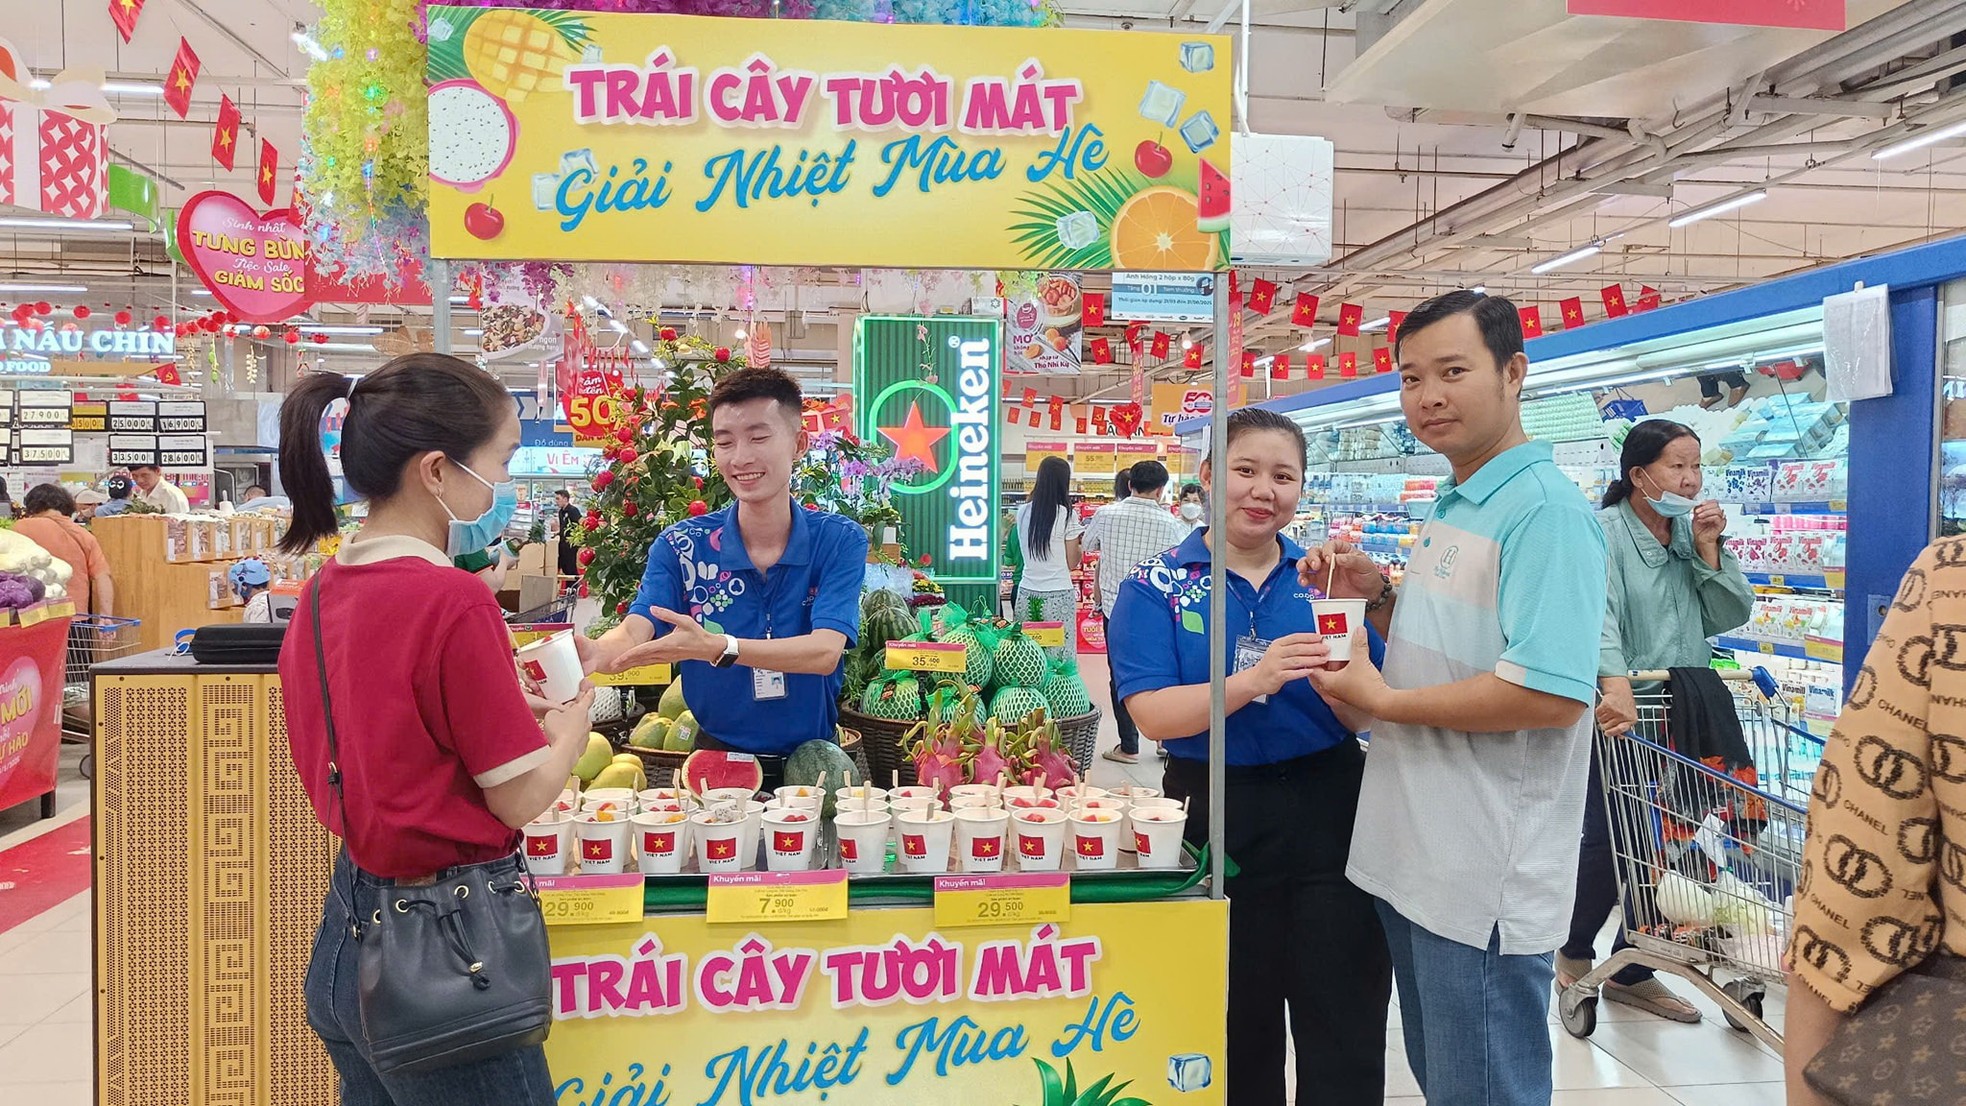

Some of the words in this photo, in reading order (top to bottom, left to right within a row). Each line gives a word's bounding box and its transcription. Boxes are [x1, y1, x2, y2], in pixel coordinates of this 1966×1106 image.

[570, 52, 692, 119] TRÁI
[710, 58, 813, 123] CÂY
[827, 70, 948, 126] TƯƠI
[964, 64, 1078, 131] MÁT
[556, 158, 673, 232] Giải
[695, 138, 857, 212] Nhiệt
[872, 134, 1007, 198] Mùa
[214, 269, 265, 291] GIẢM
[270, 269, 305, 293] SỐC
[263, 260, 291, 274] Sale
[13, 320, 84, 352] NẤU
[90, 325, 176, 354] CHÍN
[6, 360, 51, 373] FOOD
[950, 338, 990, 561] Heineken
[1877, 699, 1931, 733] CHANEL
[1843, 800, 1889, 836] CHANEL
[713, 874, 744, 886] Khuyến
[746, 873, 762, 883] mãi
[939, 878, 969, 889] Khuyến
[971, 877, 986, 887] mãi
[1811, 893, 1851, 929] CHANEL
[551, 939, 682, 1014] TRÁI
[701, 938, 812, 1006] CÂY
[827, 938, 957, 1002] TƯƠI
[974, 924, 1096, 996] MÁT
[696, 1026, 868, 1106] Nhiệt
[886, 1015, 1029, 1086] Mùa
